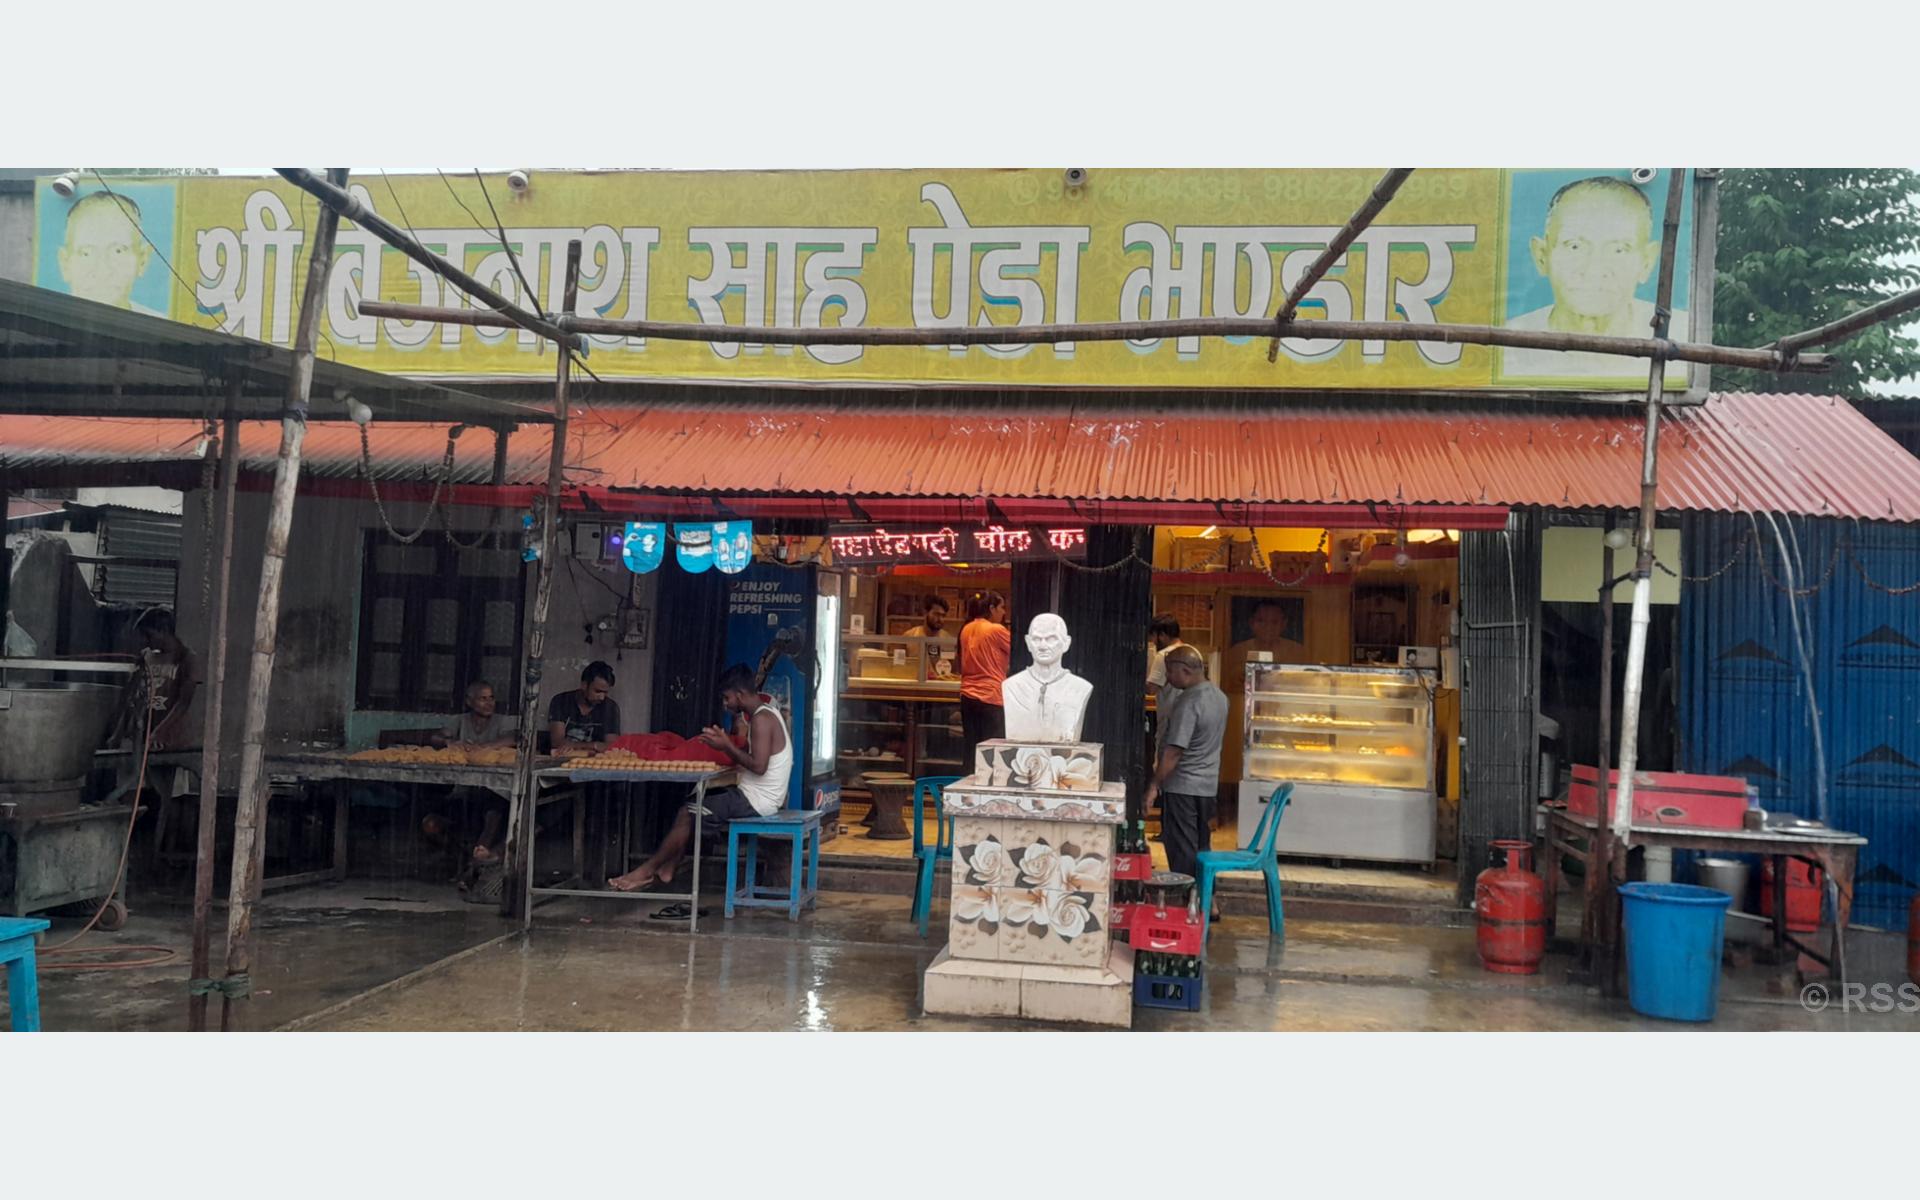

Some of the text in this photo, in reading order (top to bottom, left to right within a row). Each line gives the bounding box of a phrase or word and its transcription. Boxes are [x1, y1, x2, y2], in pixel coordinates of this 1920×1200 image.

[195, 188, 305, 344] श्री
[687, 226, 879, 365] साह
[907, 181, 1091, 354] पेडा
[1119, 221, 1478, 365] भण्डार
[742, 581, 781, 591] ENJOY
[729, 592, 802, 603] REFRESHING
[729, 604, 762, 614] PEPSI
